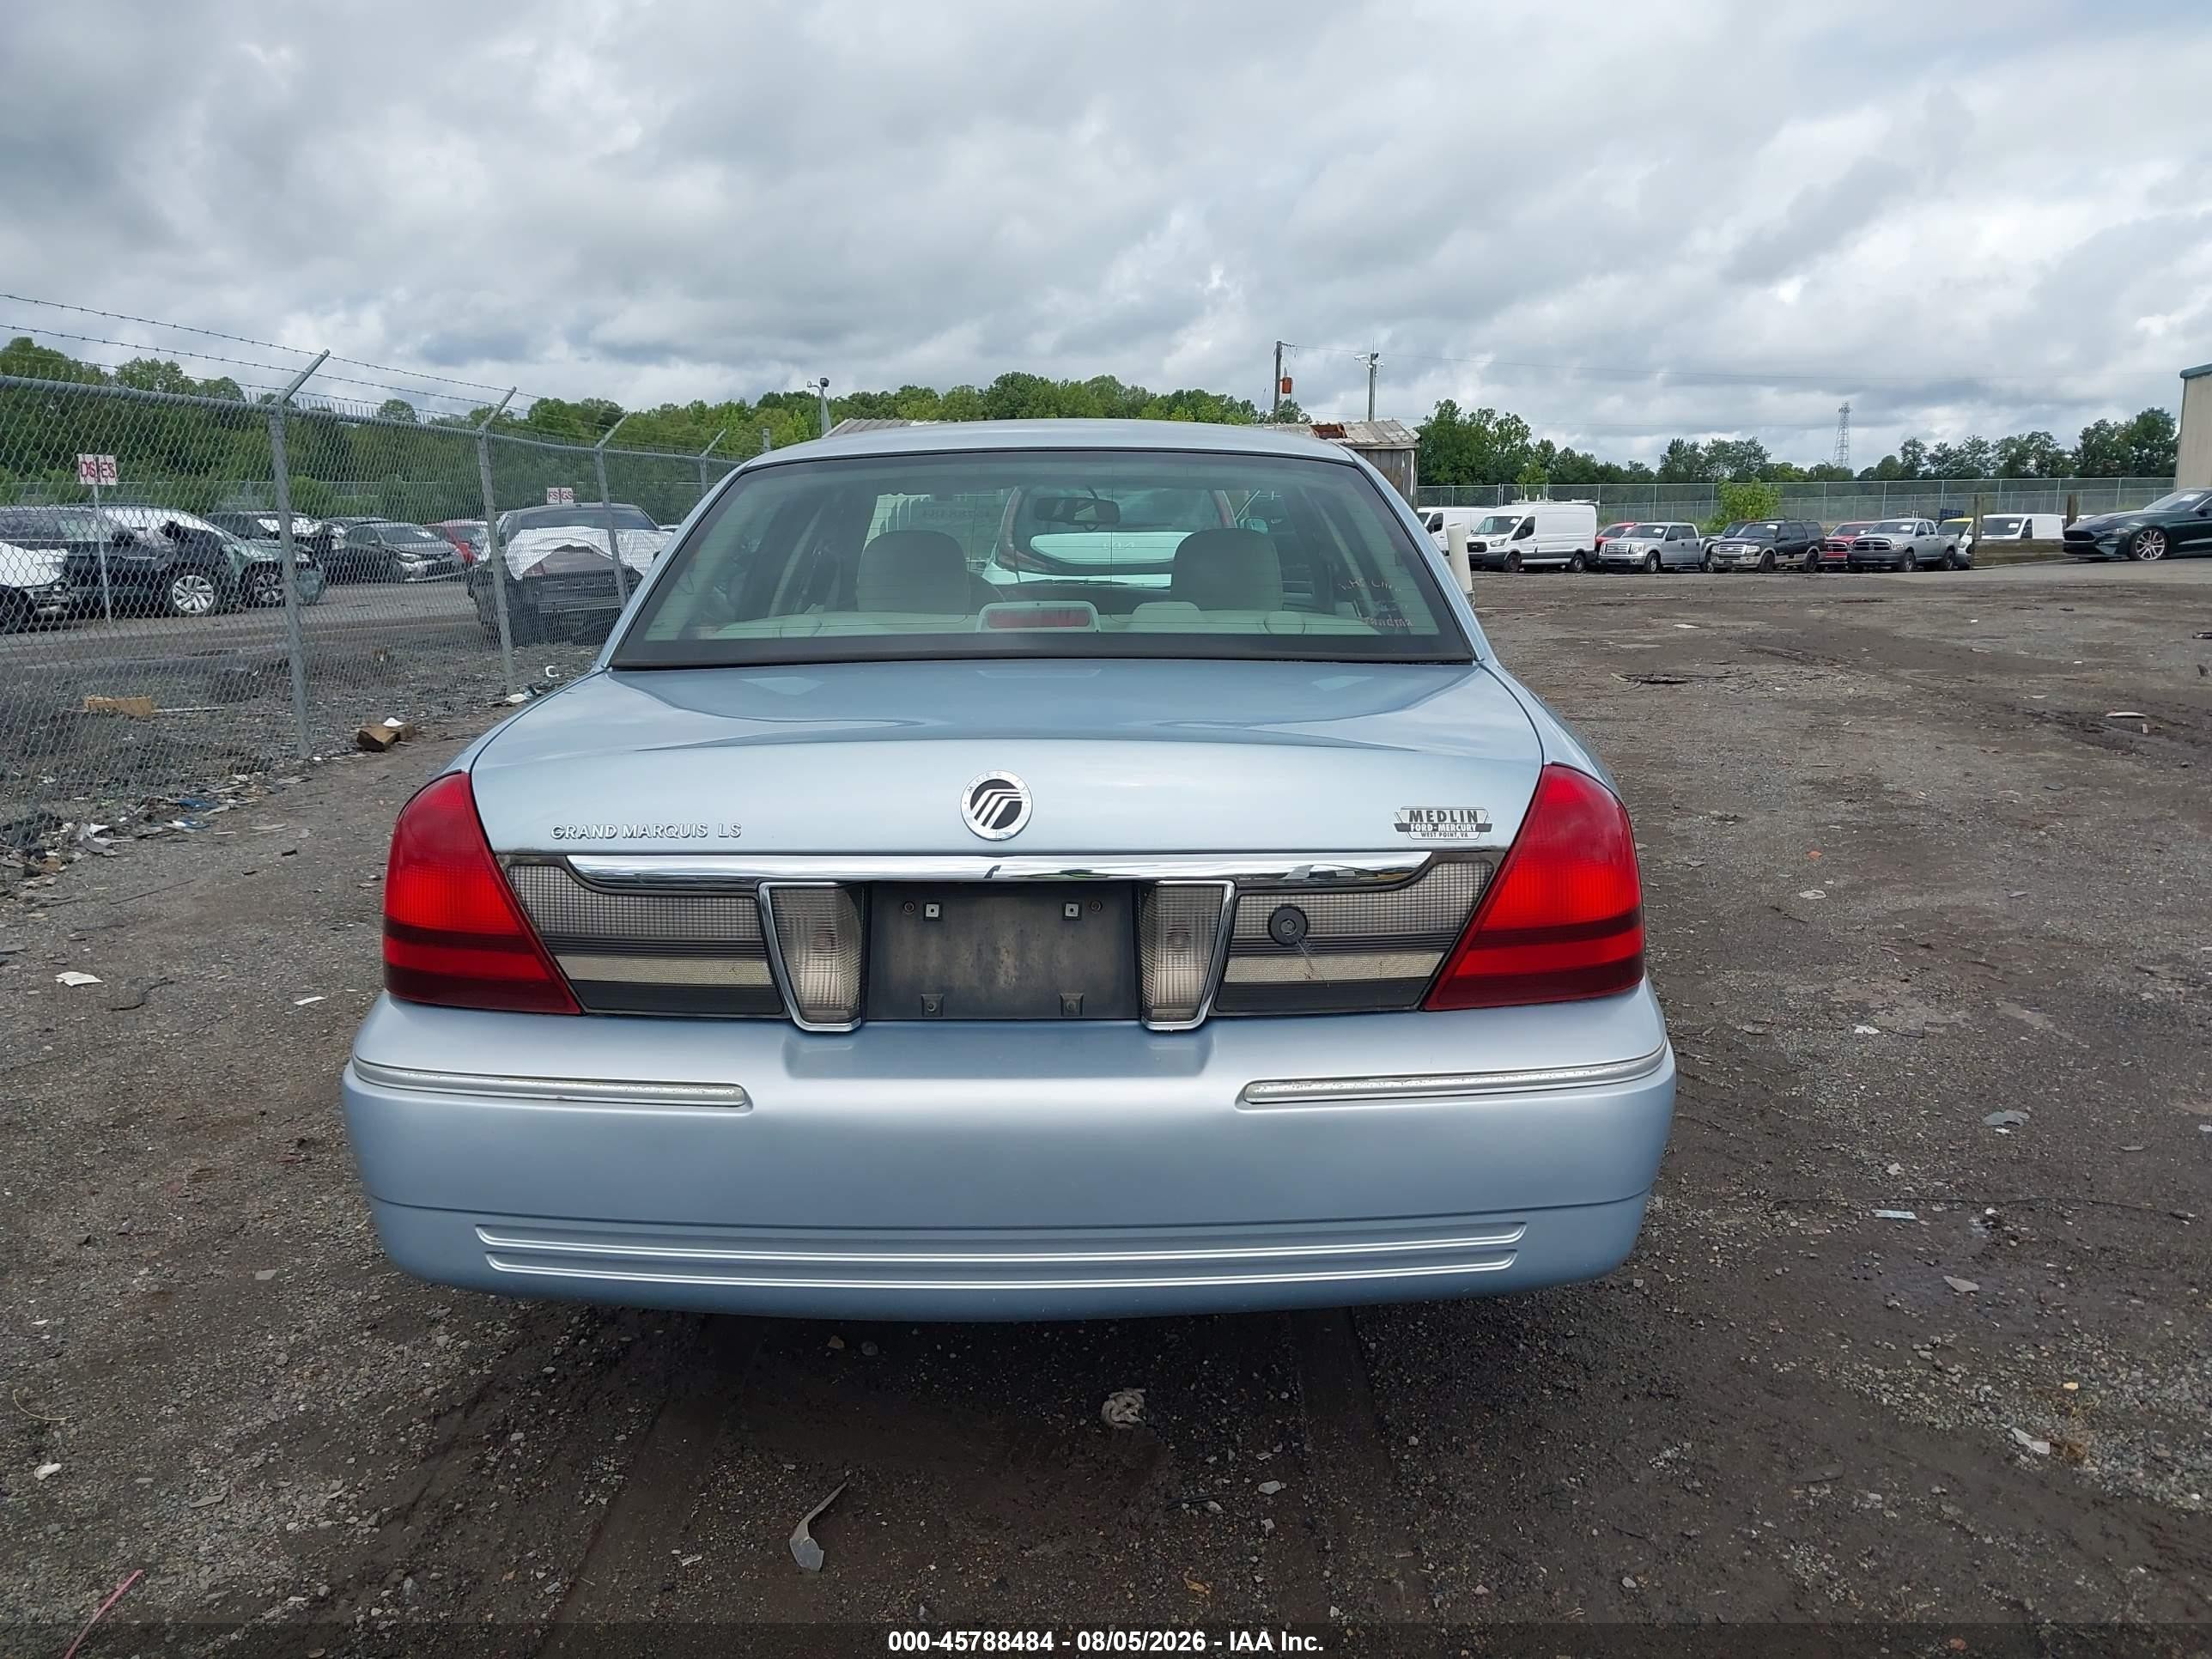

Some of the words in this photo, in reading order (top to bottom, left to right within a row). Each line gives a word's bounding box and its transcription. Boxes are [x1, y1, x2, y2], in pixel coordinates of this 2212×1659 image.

[1408, 810, 1479, 823] MEDLIN
[550, 823, 618, 839] GRAND
[622, 823, 708, 839] MARQUIS
[718, 823, 743, 838] LS
[1410, 823, 1477, 832] FORD-MERCURY
